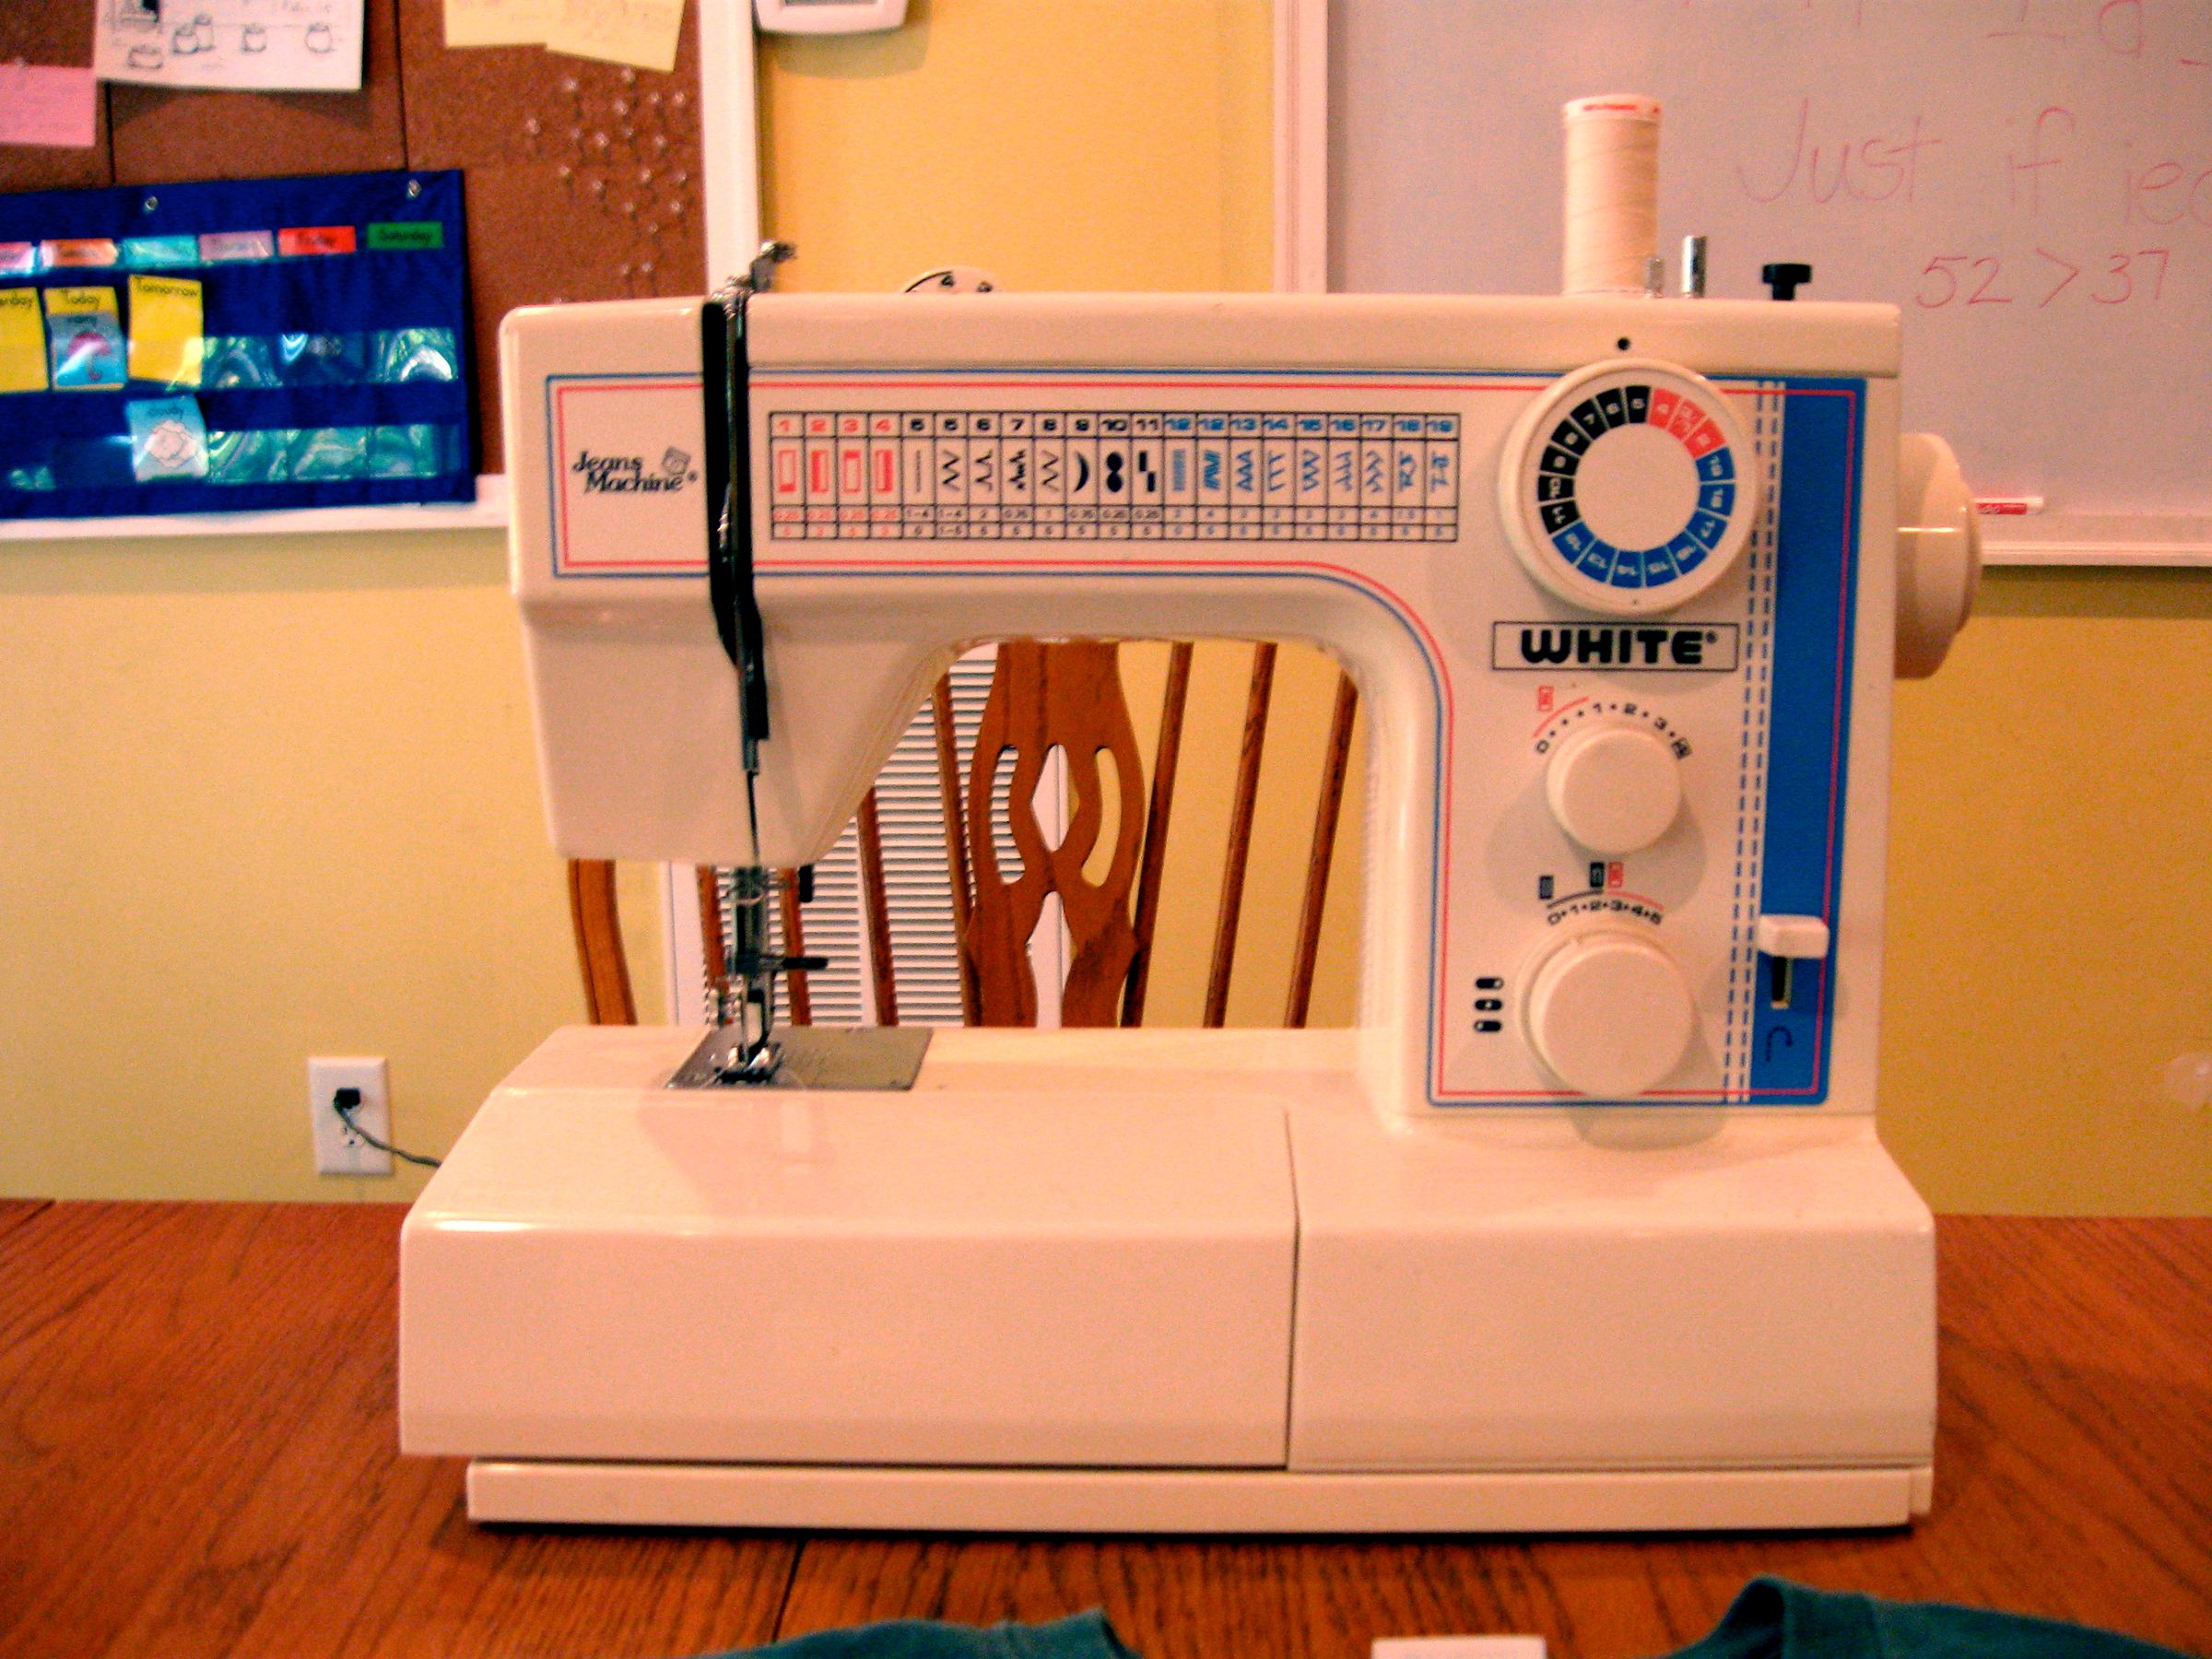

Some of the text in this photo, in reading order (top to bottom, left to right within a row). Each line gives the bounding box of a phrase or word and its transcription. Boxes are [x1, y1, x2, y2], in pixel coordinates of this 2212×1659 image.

[1735, 98, 1942, 205] Just
[2006, 106, 2076, 216] if
[134, 275, 196, 297] Tomorrow
[1915, 254, 2012, 309] 52
[2090, 249, 2170, 305] 37
[59, 288, 100, 310] Today
[780, 418, 790, 431] 1
[811, 418, 826, 431] 2
[844, 418, 859, 431] 3
[876, 418, 890, 431] 4
[977, 418, 991, 431] 6
[1012, 418, 1023, 431] 7
[1102, 418, 1126, 431] 10
[1137, 418, 1158, 431] 11
[1166, 418, 1190, 431] 12
[1198, 418, 1224, 431] 12
[1230, 418, 1255, 431] 13
[1263, 418, 1288, 431] 14
[1298, 418, 1322, 431] 15
[1331, 418, 1355, 431] 16
[1361, 418, 1385, 431] 17
[1396, 418, 1420, 432] 18
[1427, 418, 1453, 432] 19
[572, 450, 643, 473] Jeans
[583, 469, 684, 494] Machine
[1522, 629, 1703, 664] WHITE
